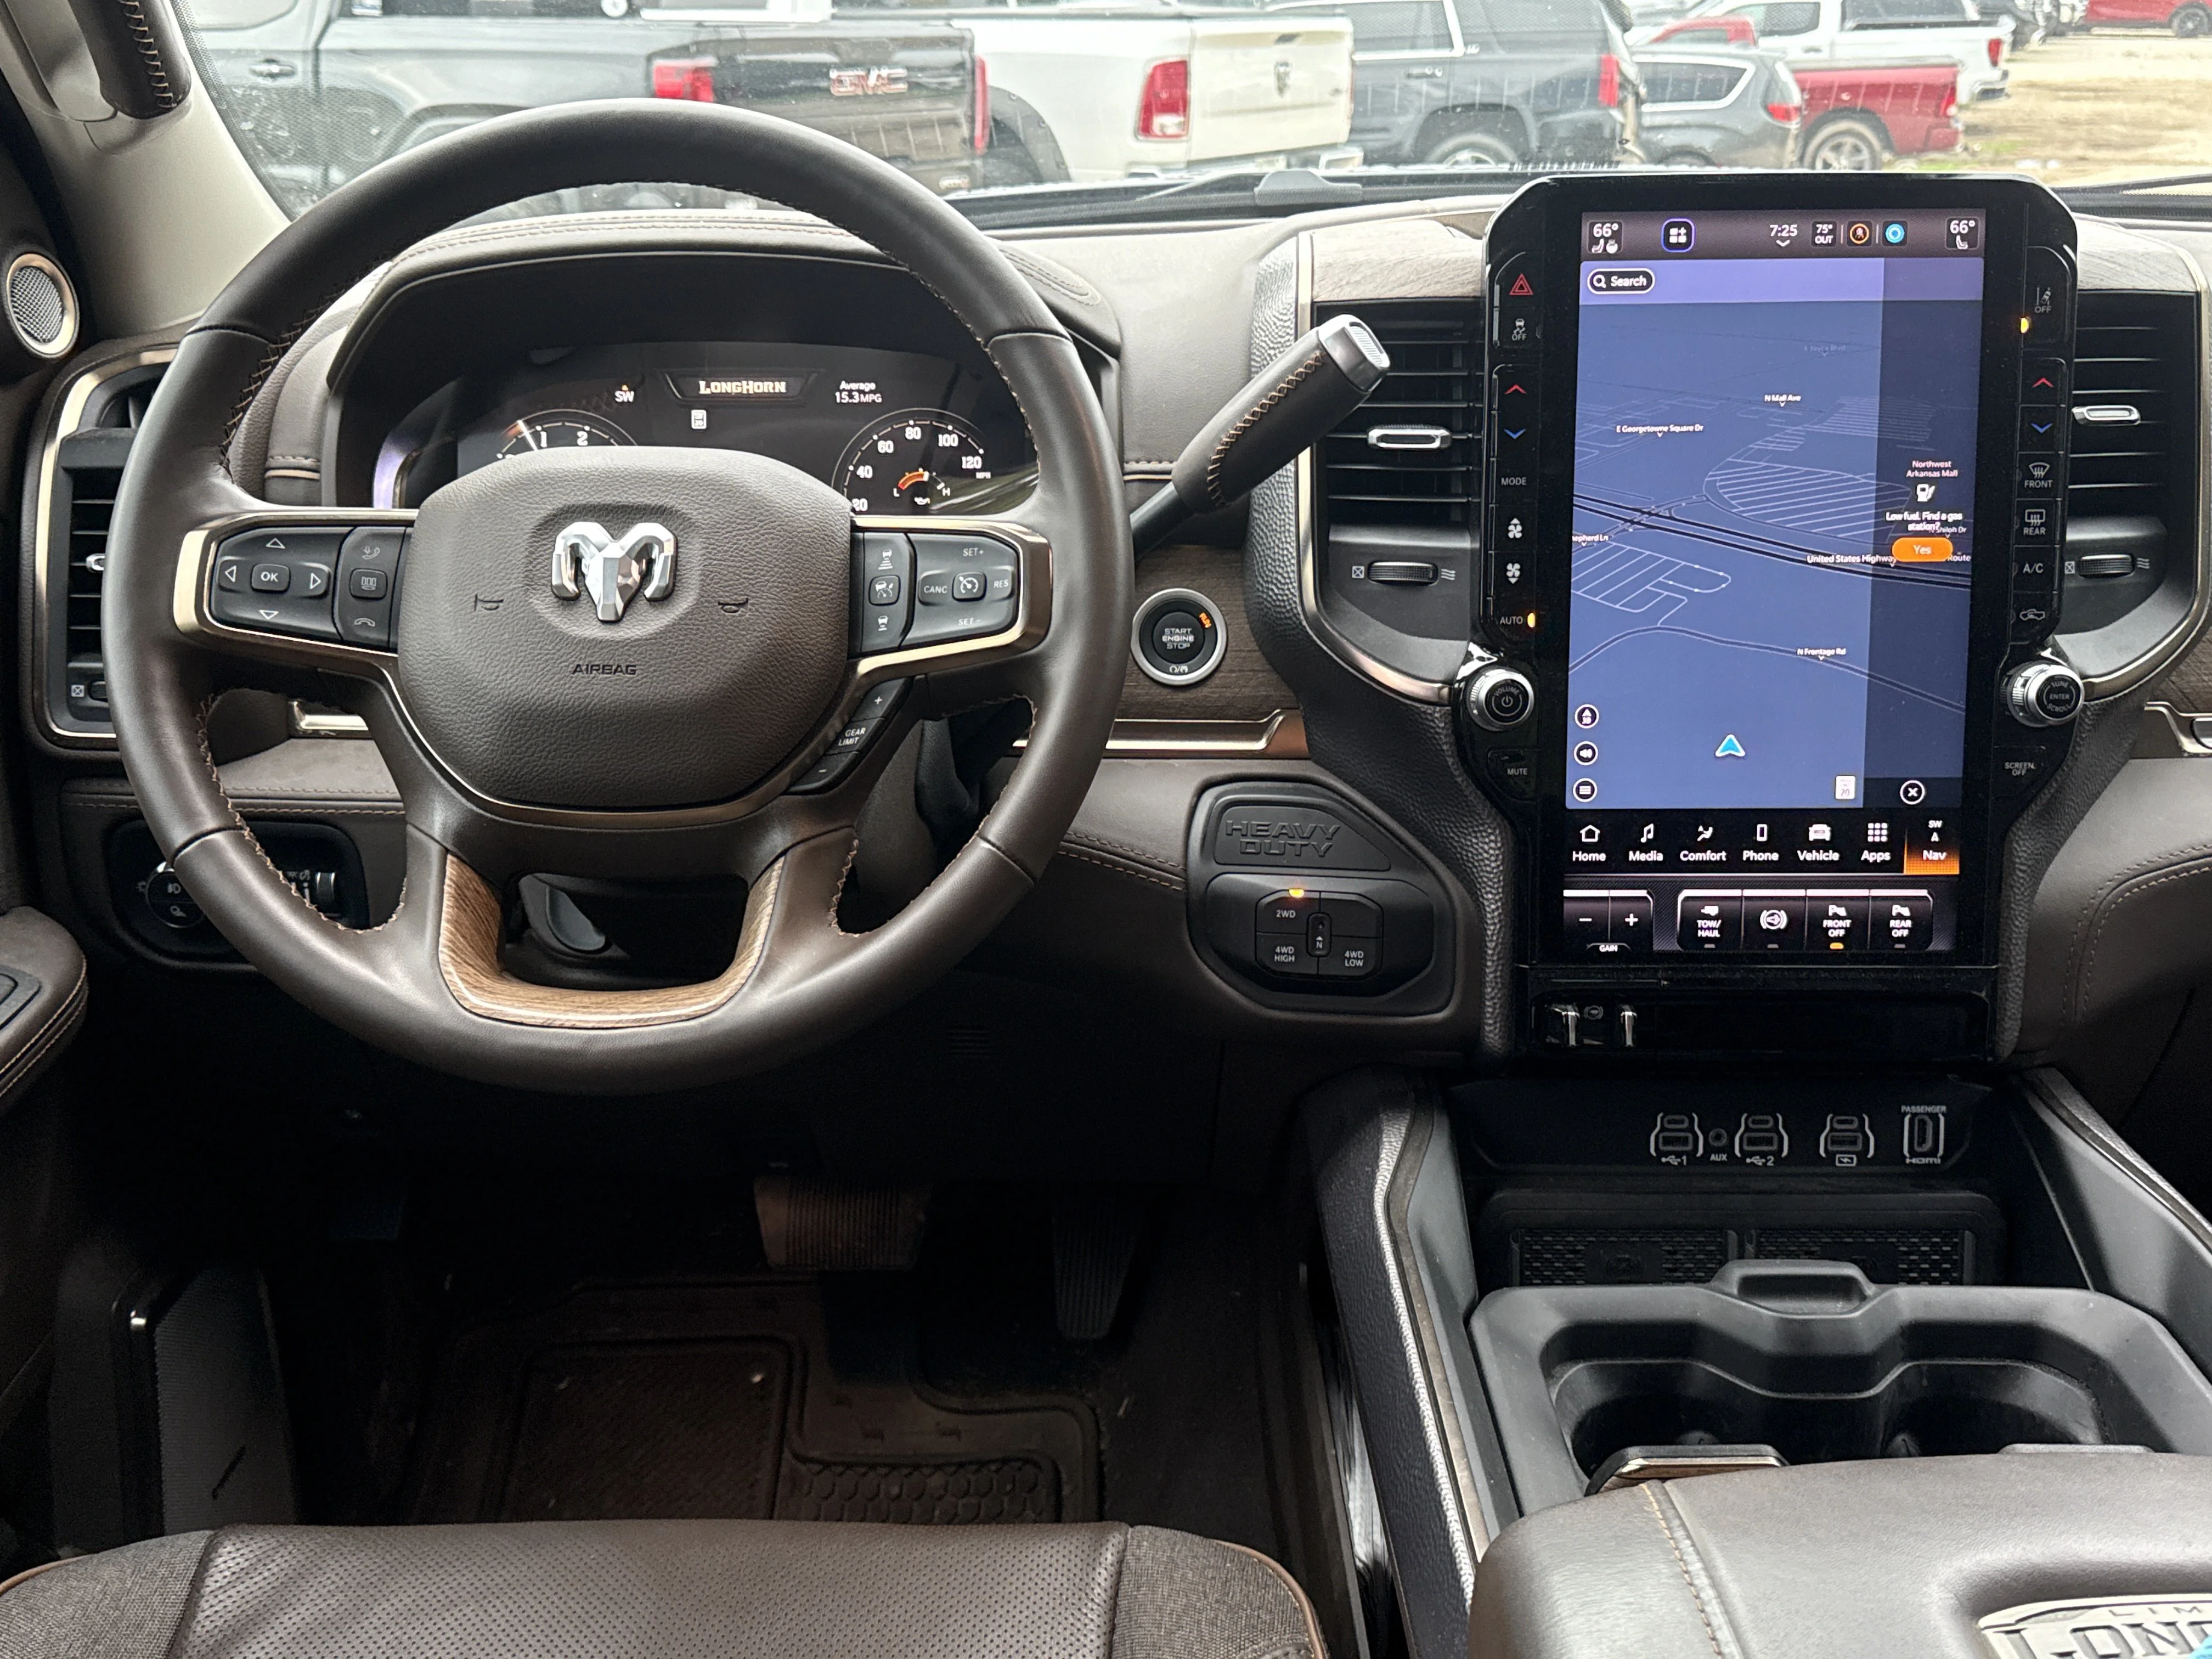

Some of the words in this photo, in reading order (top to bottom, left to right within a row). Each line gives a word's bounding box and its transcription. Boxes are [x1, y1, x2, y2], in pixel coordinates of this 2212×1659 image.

[829, 66, 909, 96] GMC
[1770, 224, 1798, 236] 7:25
[1816, 224, 1833, 234] 75°
[1815, 235, 1833, 244] OUT
[1610, 275, 1647, 287] Search
[839, 381, 876, 391] Average
[615, 391, 634, 403] SW
[905, 427, 921, 440] 80
[1669, 425, 1692, 433] Square
[1694, 424, 1703, 432] Dr
[539, 431, 547, 447] 1
[577, 431, 588, 447] 2
[938, 434, 958, 447] 100
[878, 440, 894, 454] 60
[961, 456, 982, 469] 120
[856, 465, 872, 479] 40
[1906, 470, 1940, 478] Arkansas
[1501, 478, 1527, 486] MODE
[2024, 479, 2053, 488] FRONT
[893, 488, 899, 496] L
[943, 488, 950, 496] H
[851, 498, 868, 512] 20
[1886, 512, 1903, 521] Low
[1922, 511, 1940, 520] Find
[1948, 513, 1962, 522] gas
[1908, 522, 1940, 531] station?
[1914, 544, 1931, 554] Yes
[1862, 555, 1897, 565] Highway
[2023, 563, 2044, 573] A/C
[261, 572, 279, 582] OK
[994, 579, 1009, 589] RES
[924, 585, 947, 594] CANC
[1499, 616, 1523, 624] AUTO
[1804, 648, 1835, 657] Frontage
[572, 663, 637, 676] AIRBAG
[1493, 686, 1520, 696] VOLUME
[2047, 703, 2072, 712] SCROLL
[845, 727, 866, 736] GEAR
[838, 736, 860, 746] LIMIT
[1841, 788, 1850, 797] 20
[1928, 820, 1943, 828] SW
[1226, 819, 1341, 840] HEAVY
[1239, 838, 1333, 857] DUTY
[1572, 851, 1606, 861] Home
[1629, 850, 1663, 861] Media
[1680, 850, 1726, 861] Comfort
[1743, 850, 1779, 861] Phone
[1797, 850, 1839, 861] Vehicle
[1861, 850, 1891, 862] Apps
[1923, 849, 1948, 860] Nav
[1276, 910, 1296, 918] 2WD
[1697, 919, 1722, 928] TOW/
[1822, 919, 1852, 928] FRONT
[1889, 919, 1912, 928] REAR
[1828, 929, 1844, 937] OFF
[1892, 929, 1909, 937] OFF
[1274, 946, 1294, 955] 4WD
[1344, 950, 1364, 958] 4WD
[1274, 954, 1295, 963] HIGH
[1345, 958, 1364, 967] LOW
[1901, 1105, 1946, 1113] PASSENGER
[1681, 1155, 1687, 1166] 1
[1767, 1155, 1774, 1166] 2
